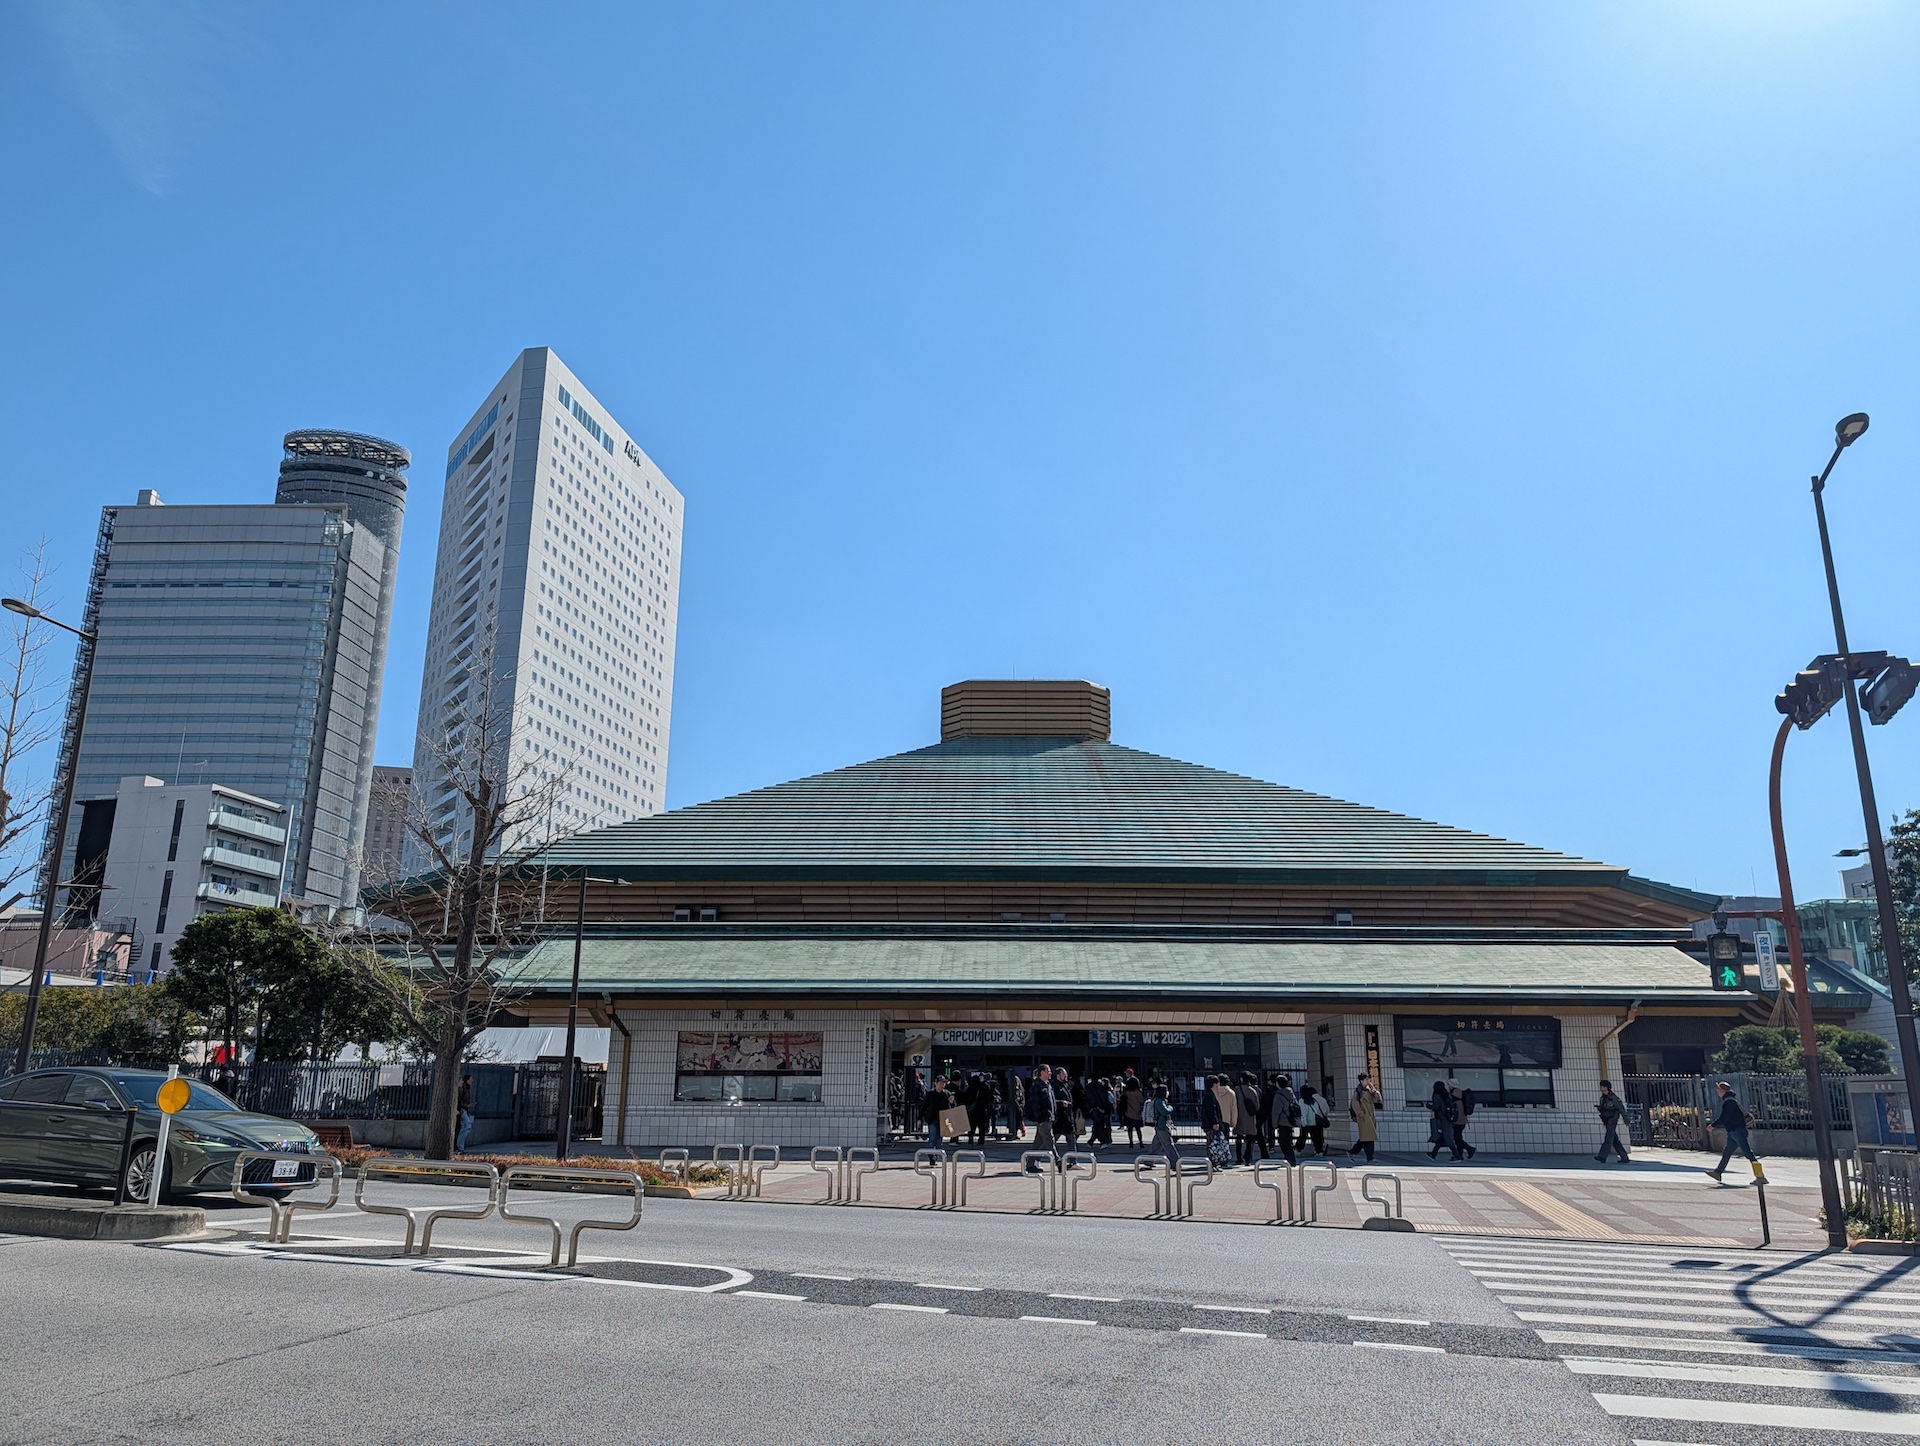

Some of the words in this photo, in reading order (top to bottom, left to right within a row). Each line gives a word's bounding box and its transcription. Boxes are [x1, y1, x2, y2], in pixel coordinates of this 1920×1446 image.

[943, 1030, 981, 1042] CAPCOM
[984, 1031, 1003, 1042] CUP
[1005, 1031, 1014, 1042] 12
[1111, 1032, 1136, 1044] SFL:
[1142, 1032, 1158, 1044] WC
[1161, 1033, 1186, 1044] 2025
